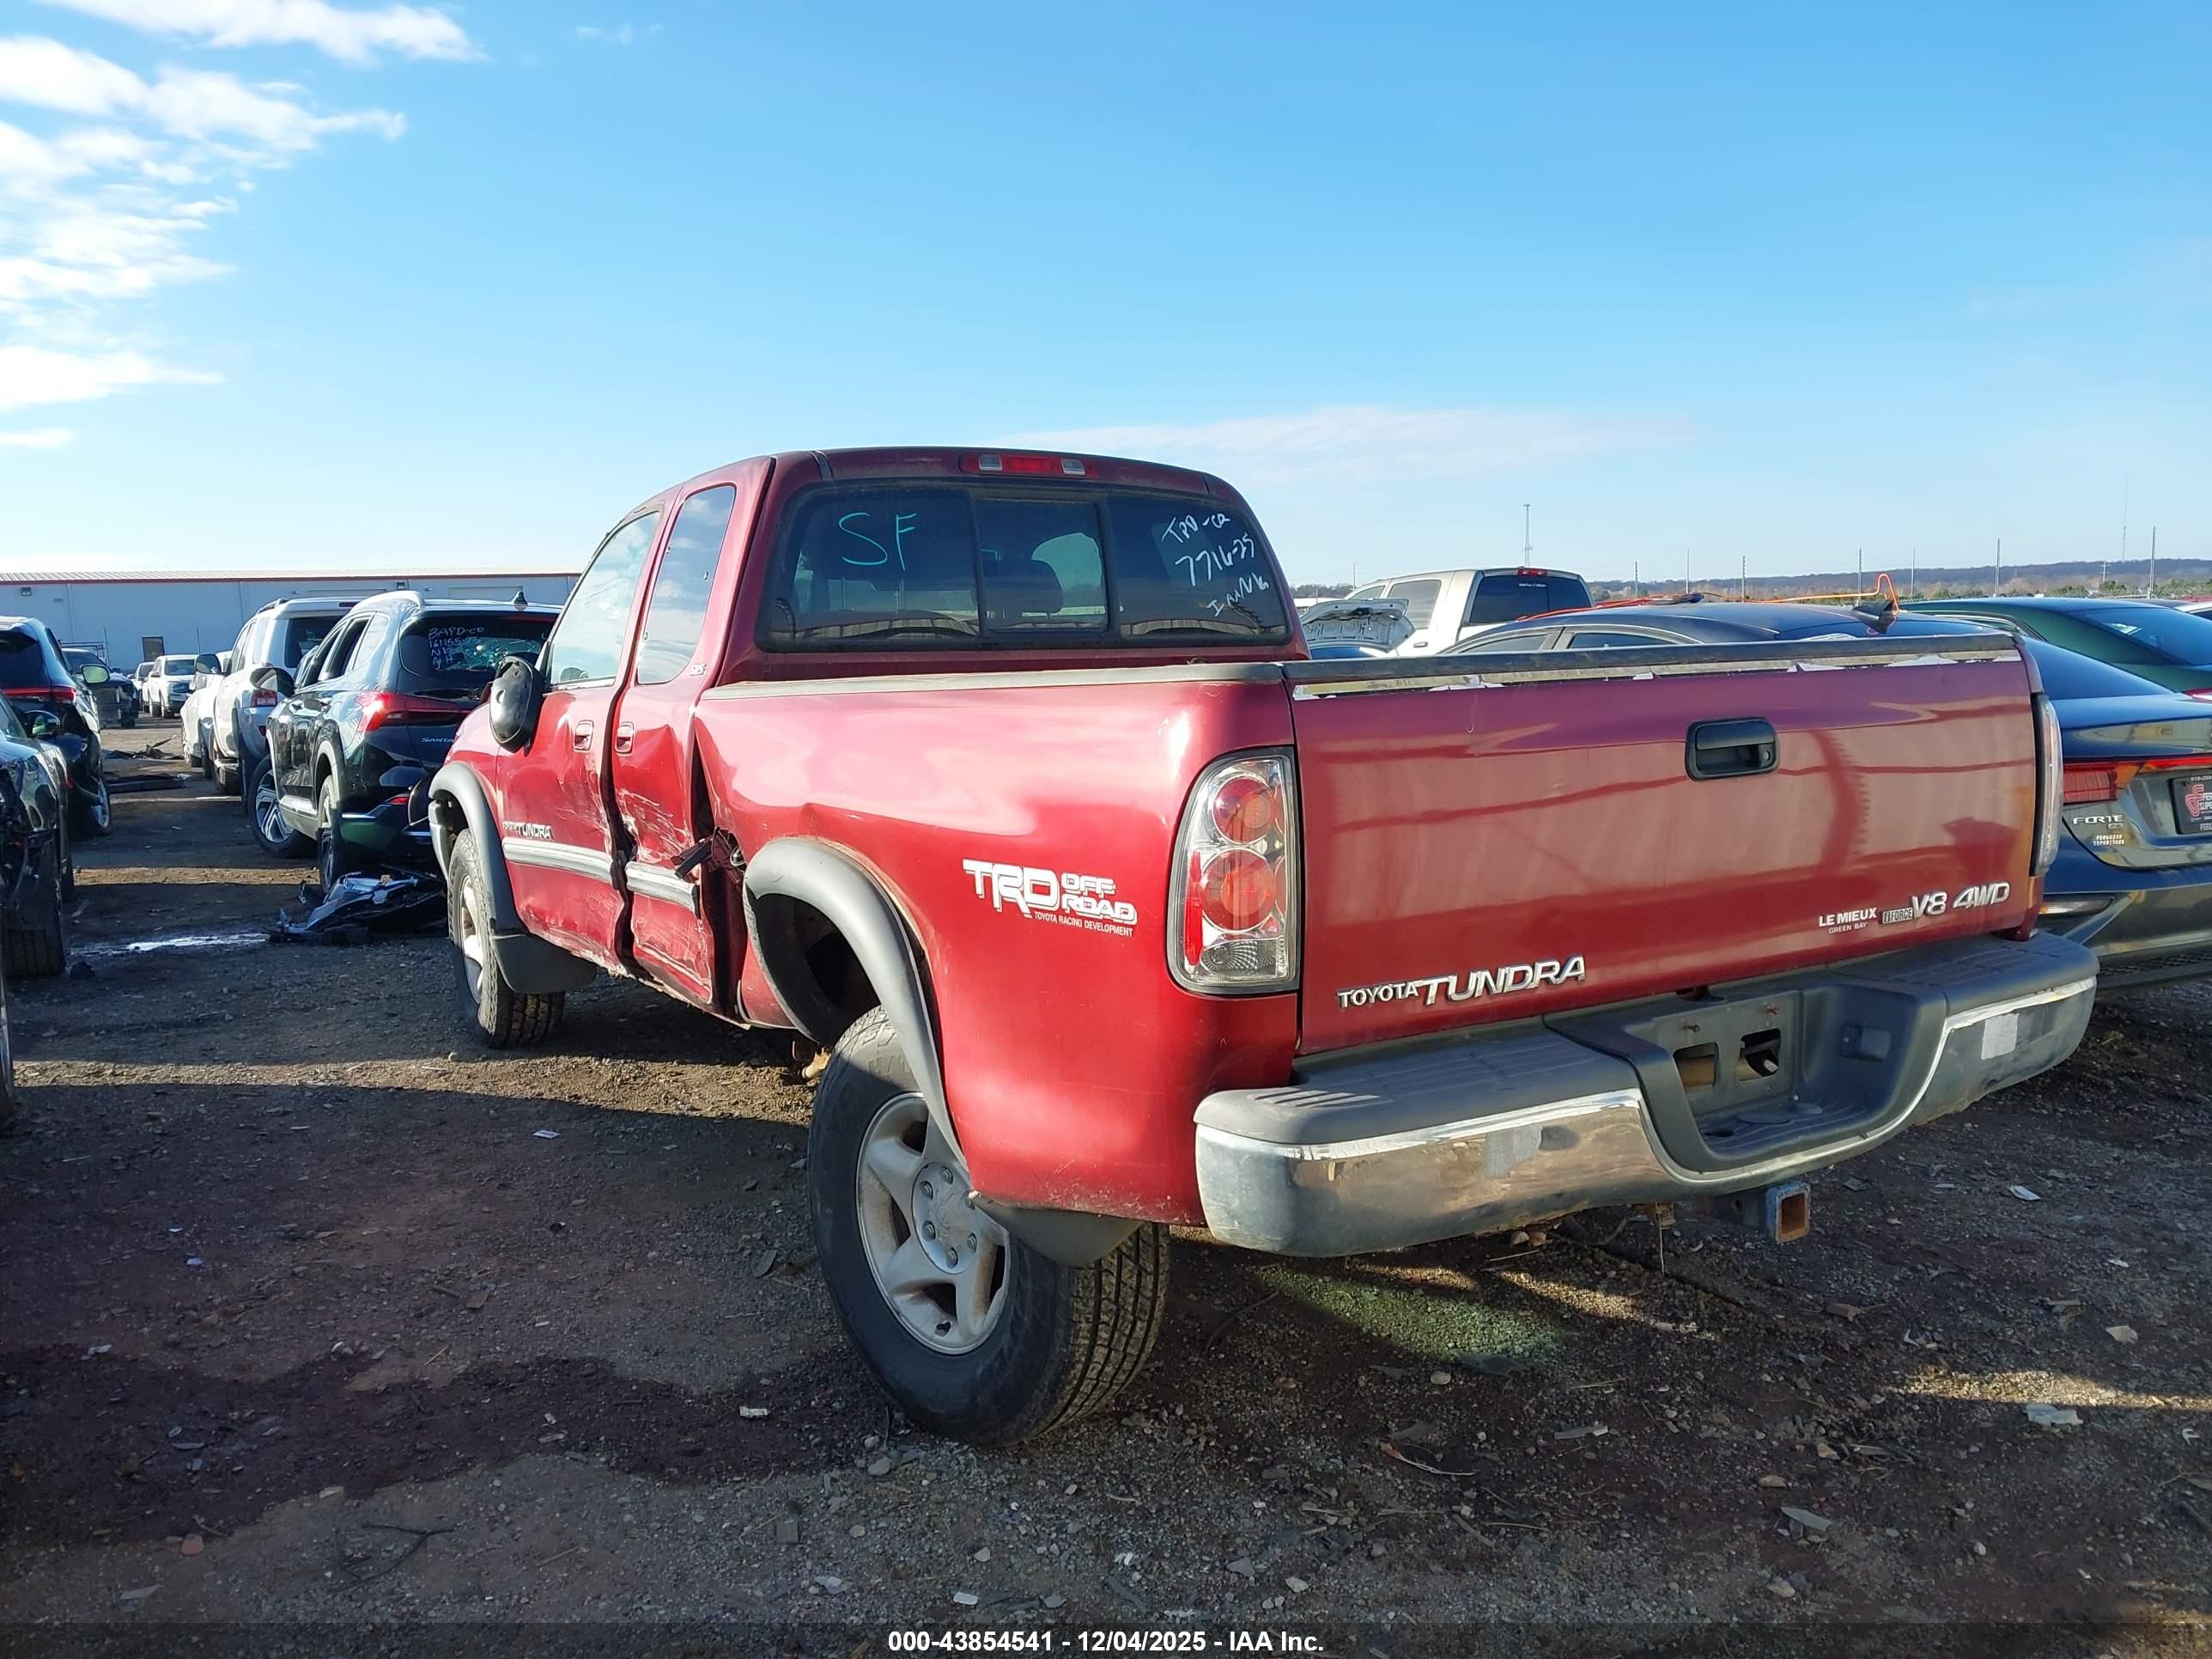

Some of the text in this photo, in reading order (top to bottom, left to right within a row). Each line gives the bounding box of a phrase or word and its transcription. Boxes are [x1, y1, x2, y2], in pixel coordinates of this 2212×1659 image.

[839, 512, 917, 571] SF
[516, 822, 554, 840] TUNDRA
[2073, 815, 2124, 824] FORTE
[962, 859, 1060, 919] TRD
[1060, 872, 1116, 898] OFF
[1060, 892, 1138, 926] ROAD
[1911, 890, 1948, 921] V8
[1953, 881, 2011, 909] 4WD
[1034, 911, 1133, 937] TOYOTA RACING DEVELOPMENT
[1828, 921, 1869, 934] GREEN BAY
[1837, 907, 1878, 924] MIEUX
[1337, 954, 1586, 1009] TOYOTA TUNDRA
